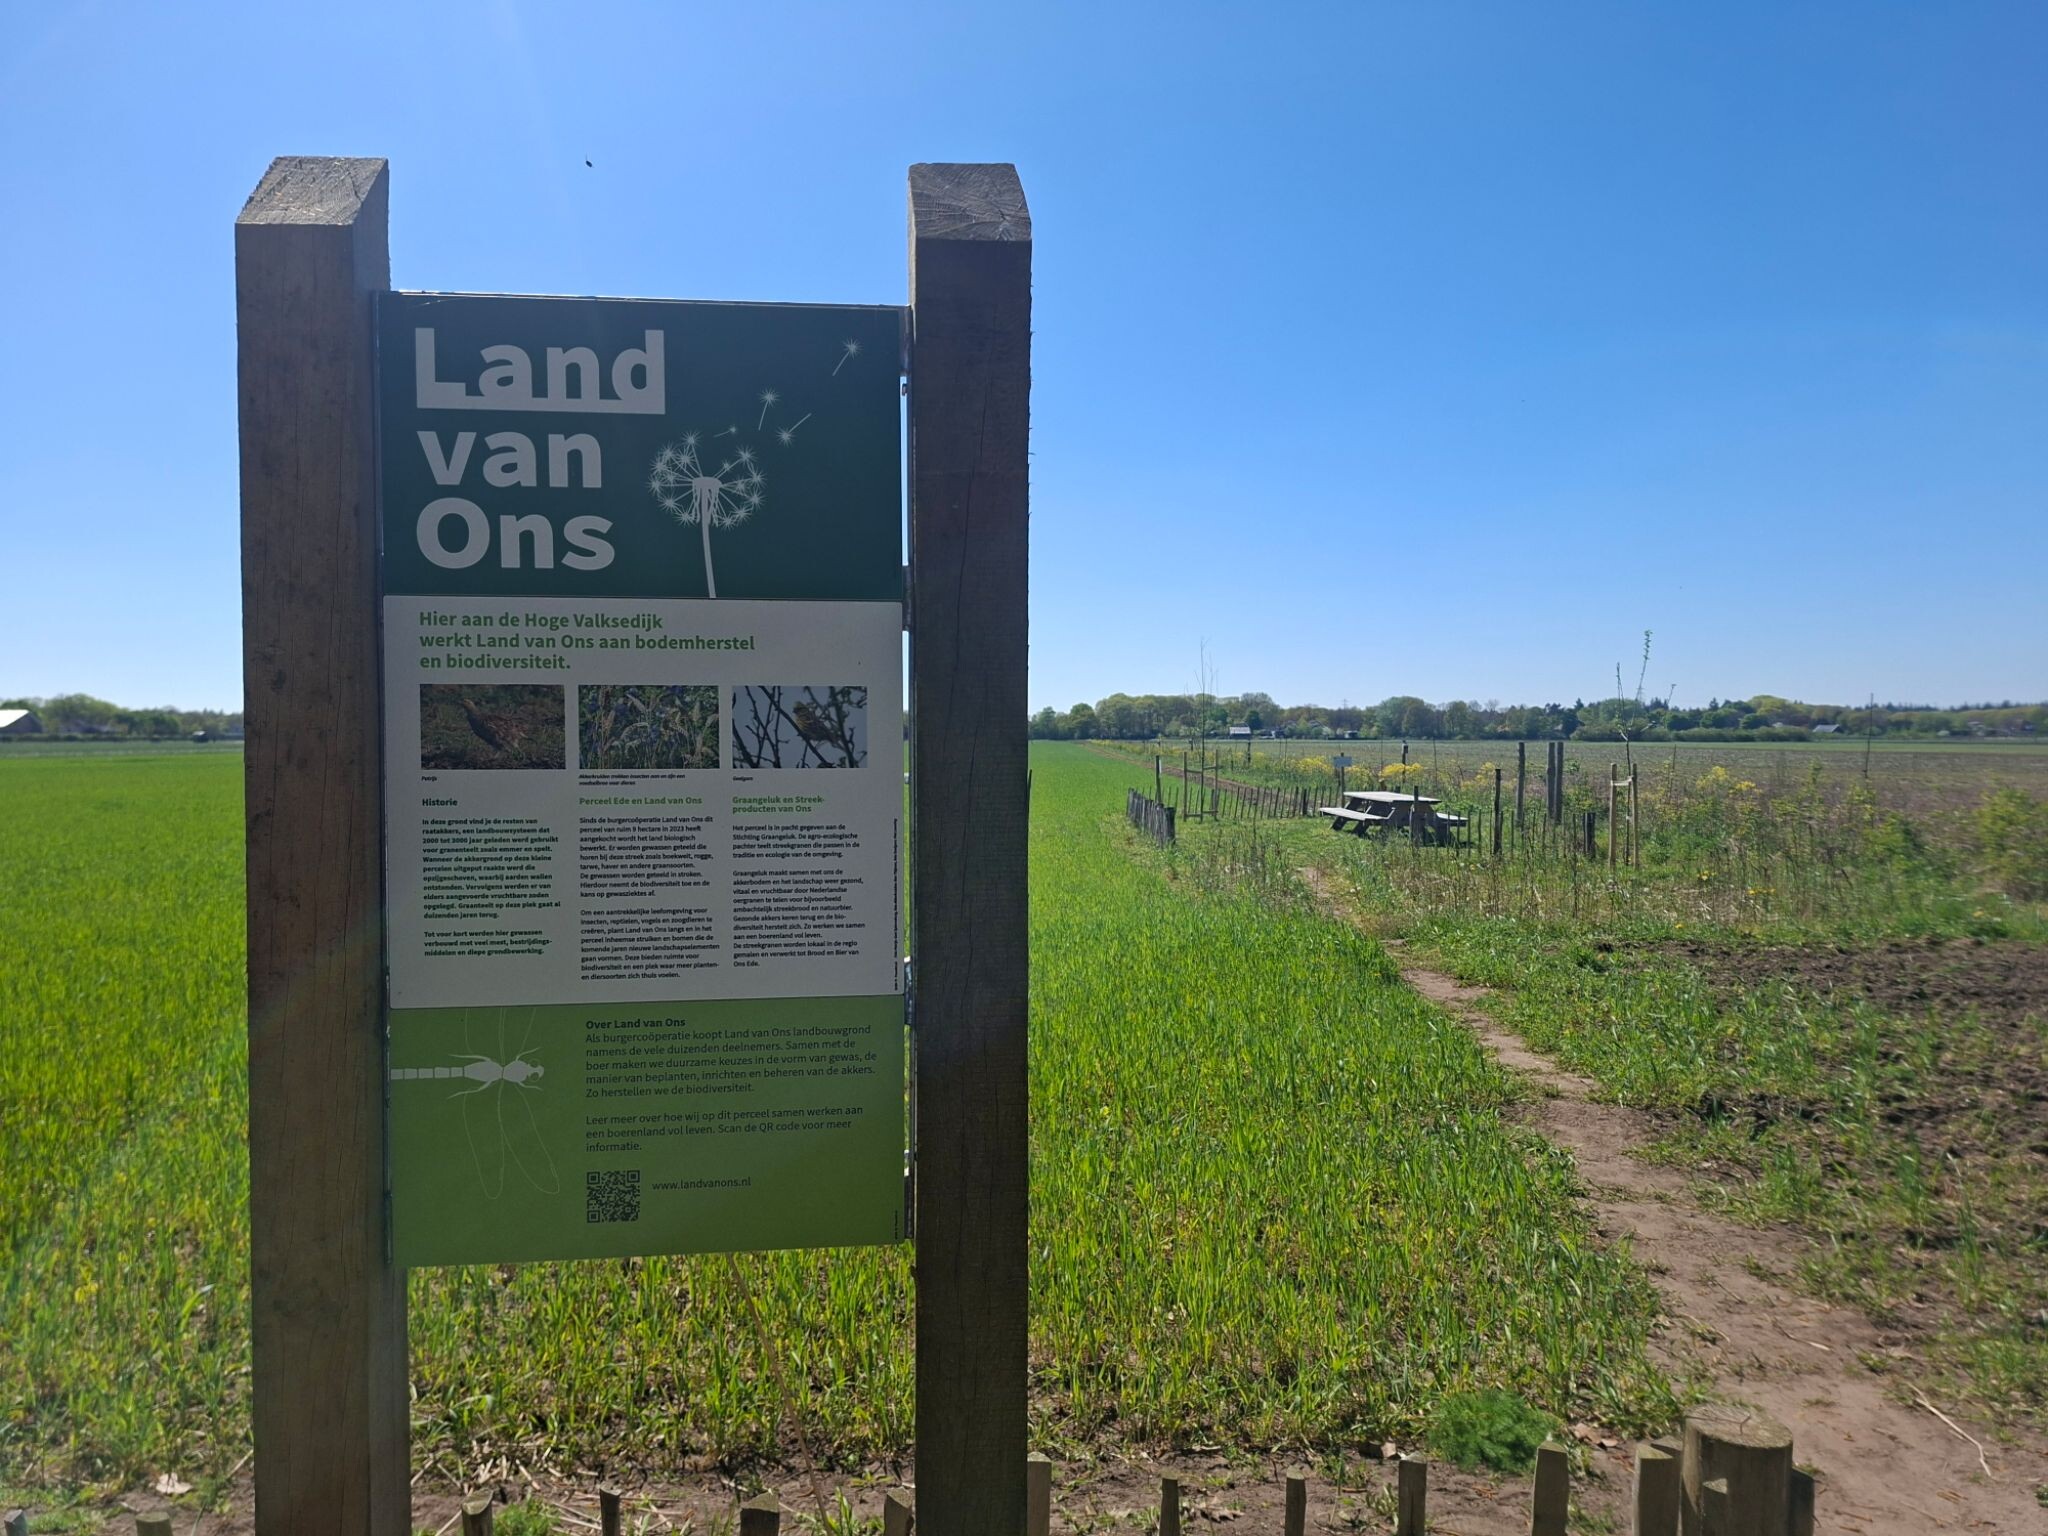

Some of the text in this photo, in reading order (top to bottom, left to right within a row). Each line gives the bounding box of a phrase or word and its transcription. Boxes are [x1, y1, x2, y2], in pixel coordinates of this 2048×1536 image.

[416, 328, 666, 414] Land
[417, 431, 602, 488] van
[416, 497, 615, 571] Ons
[419, 611, 664, 632] Hier aan de Hoge Valksedijk
[419, 632, 755, 650] werkt Land van Ons aan bodemherstel
[419, 653, 572, 669] en biodiversiteit.
[732, 796, 780, 806] Graangeluk
[732, 805, 776, 814] producten
[586, 1020, 612, 1029] Over
[614, 1019, 640, 1028] Land
[665, 1018, 686, 1027] Ons
[585, 1033, 601, 1043] Als
[601, 1030, 690, 1045] burgercoöperatie
[692, 1030, 723, 1042] koopt
[723, 1029, 749, 1039] Land
[771, 1028, 790, 1038] Ons
[793, 1025, 871, 1040] landbouwgrond
[586, 1039, 856, 1056] namens de vele duizenden deelnemers. Samen met de
[586, 1060, 610, 1070] boer
[610, 1059, 646, 1069] maken
[666, 1056, 716, 1068] duurzame
[718, 1055, 752, 1066] keuzes
[754, 1055, 764, 1065] in
[766, 1054, 778, 1064] de
[828, 1055, 862, 1065] gewas,
[864, 1051, 878, 1062] de
[586, 1073, 623, 1084] manier
[643, 1071, 699, 1084] beplanten,
[701, 1069, 746, 1080] inrichten
[763, 1067, 804, 1078] beheren
[825, 1066, 838, 1076] de
[841, 1065, 876, 1076] akkers.
[586, 1088, 598, 1098] Zo
[600, 1086, 651, 1097] herstellen
[671, 1085, 683, 1095] de
[686, 1082, 755, 1094] biodiversiteit.
[586, 1114, 608, 1125] Leer
[663, 1111, 683, 1122] hoe
[683, 1111, 699, 1123] wij
[701, 1113, 715, 1123] op
[717, 1110, 730, 1120] dit
[733, 1108, 769, 1122] perceel
[771, 1110, 804, 1118] samen
[807, 1106, 842, 1116] werken
[607, 1126, 665, 1138] boerenland
[666, 1125, 682, 1136] vol
[685, 1124, 715, 1135] leven.
[717, 1123, 741, 1134] Scan
[744, 1123, 756, 1133] de
[759, 1122, 773, 1133] QR
[775, 1121, 800, 1132] code
[826, 1122, 852, 1130] meer
[586, 1141, 642, 1152] informatie.
[652, 1177, 751, 1189] www.landvanons.nl
